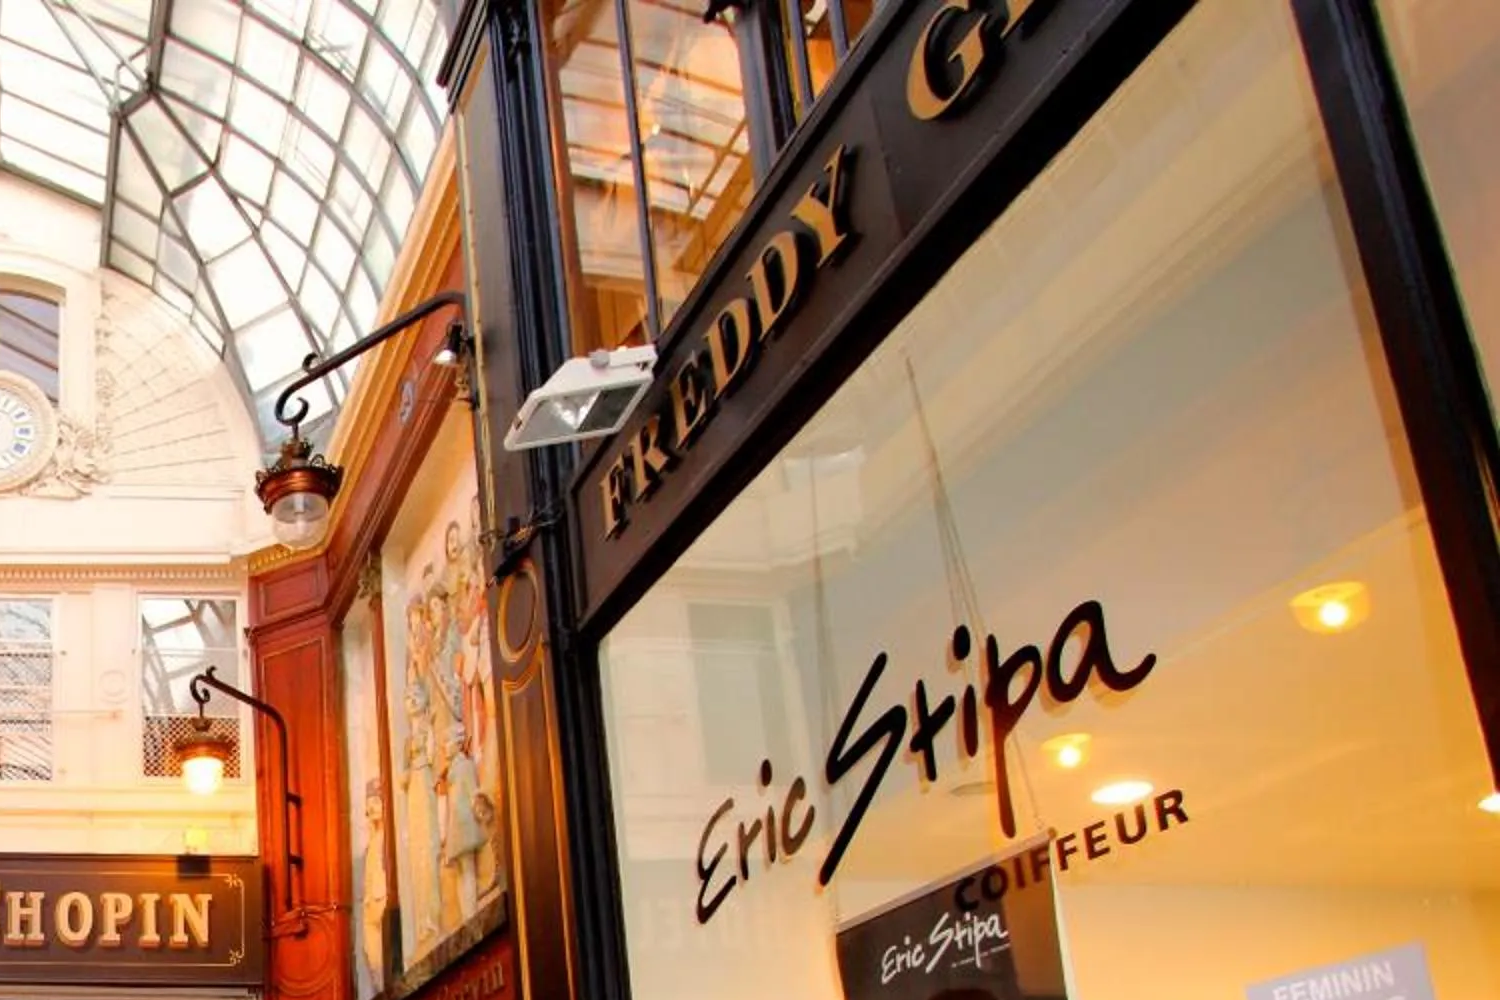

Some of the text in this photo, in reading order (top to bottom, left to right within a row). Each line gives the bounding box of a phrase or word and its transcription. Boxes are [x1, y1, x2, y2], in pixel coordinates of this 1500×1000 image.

[600, 0, 1035, 539] FREDDY G
[696, 600, 1158, 925] Eric Stipa
[954, 788, 1190, 916] COIFFEUR
[881, 911, 1009, 985] Eric Stipa
